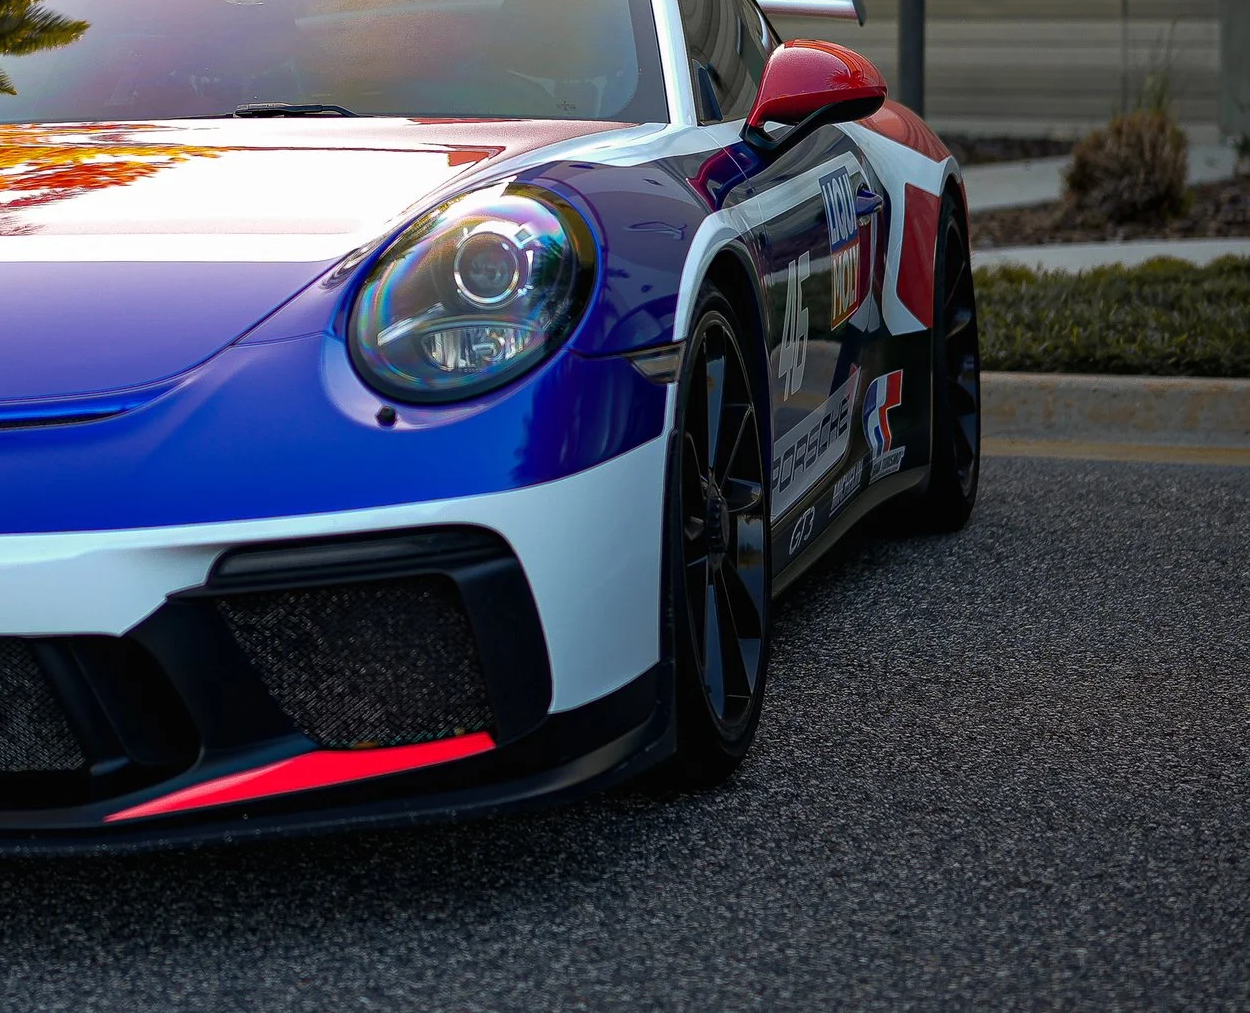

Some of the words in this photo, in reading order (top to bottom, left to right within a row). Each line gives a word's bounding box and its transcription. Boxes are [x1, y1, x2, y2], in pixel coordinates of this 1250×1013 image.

[822, 173, 857, 245] LIQUI
[832, 242, 860, 320] MOLY
[772, 393, 850, 494] PORSCHE
[789, 506, 816, 555] GT3
